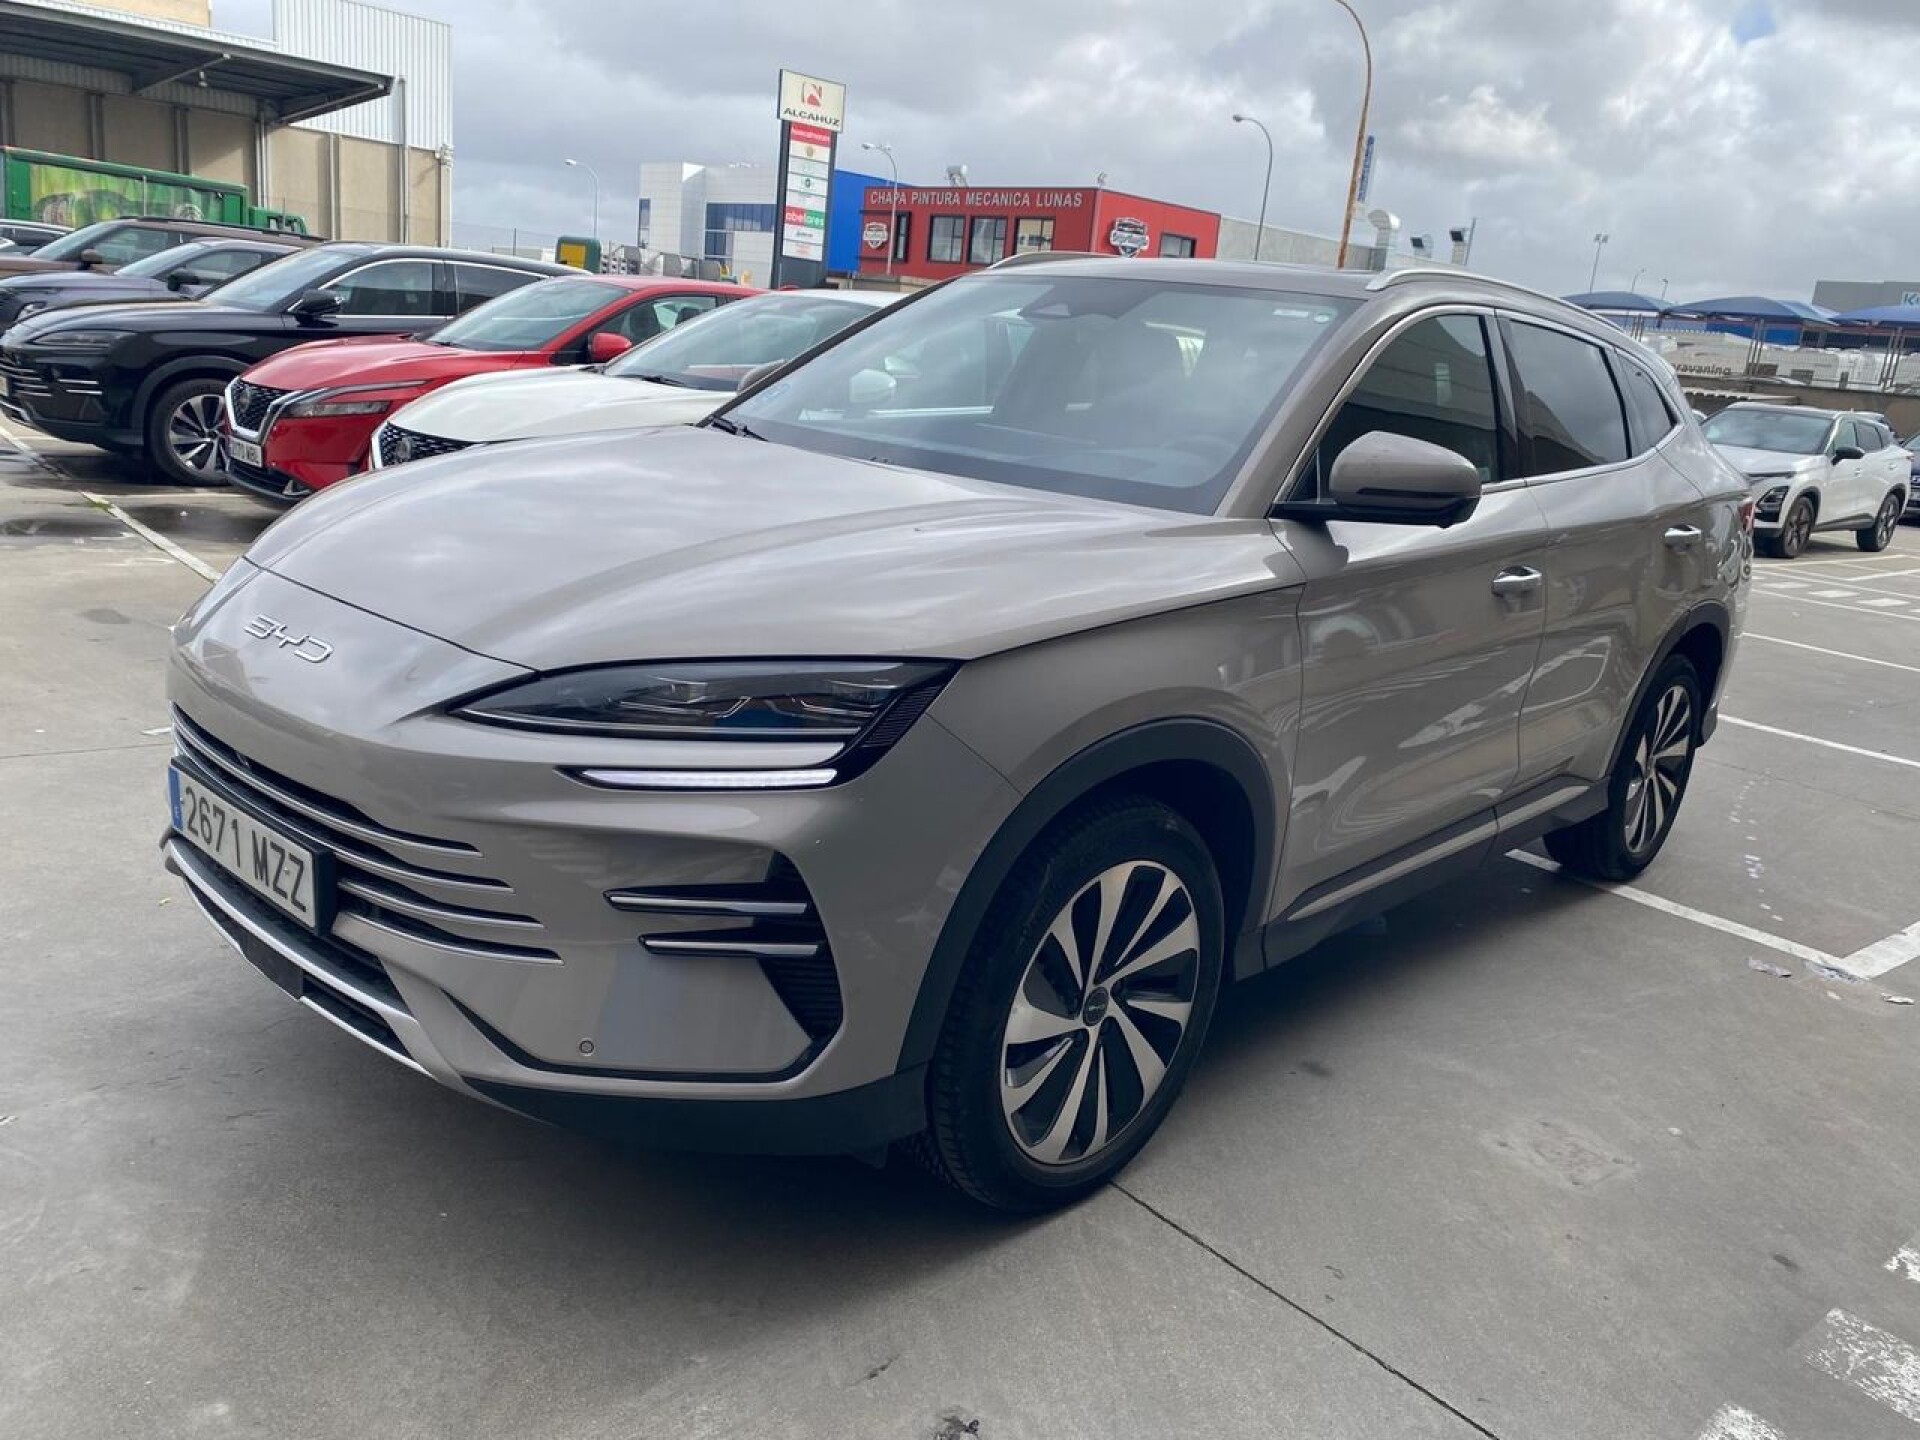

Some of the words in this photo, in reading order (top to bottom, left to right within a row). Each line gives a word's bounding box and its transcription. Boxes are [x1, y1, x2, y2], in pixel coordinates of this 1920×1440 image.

[784, 107, 840, 127] ALCAHUZ
[870, 191, 907, 205] CHAPA
[911, 191, 961, 206] PINTURA
[965, 191, 1030, 207] MECANICA
[1035, 191, 1083, 208] LUNAS
[244, 613, 334, 664] BYD
[185, 785, 242, 869] 2671
[251, 829, 307, 913] MZZ
